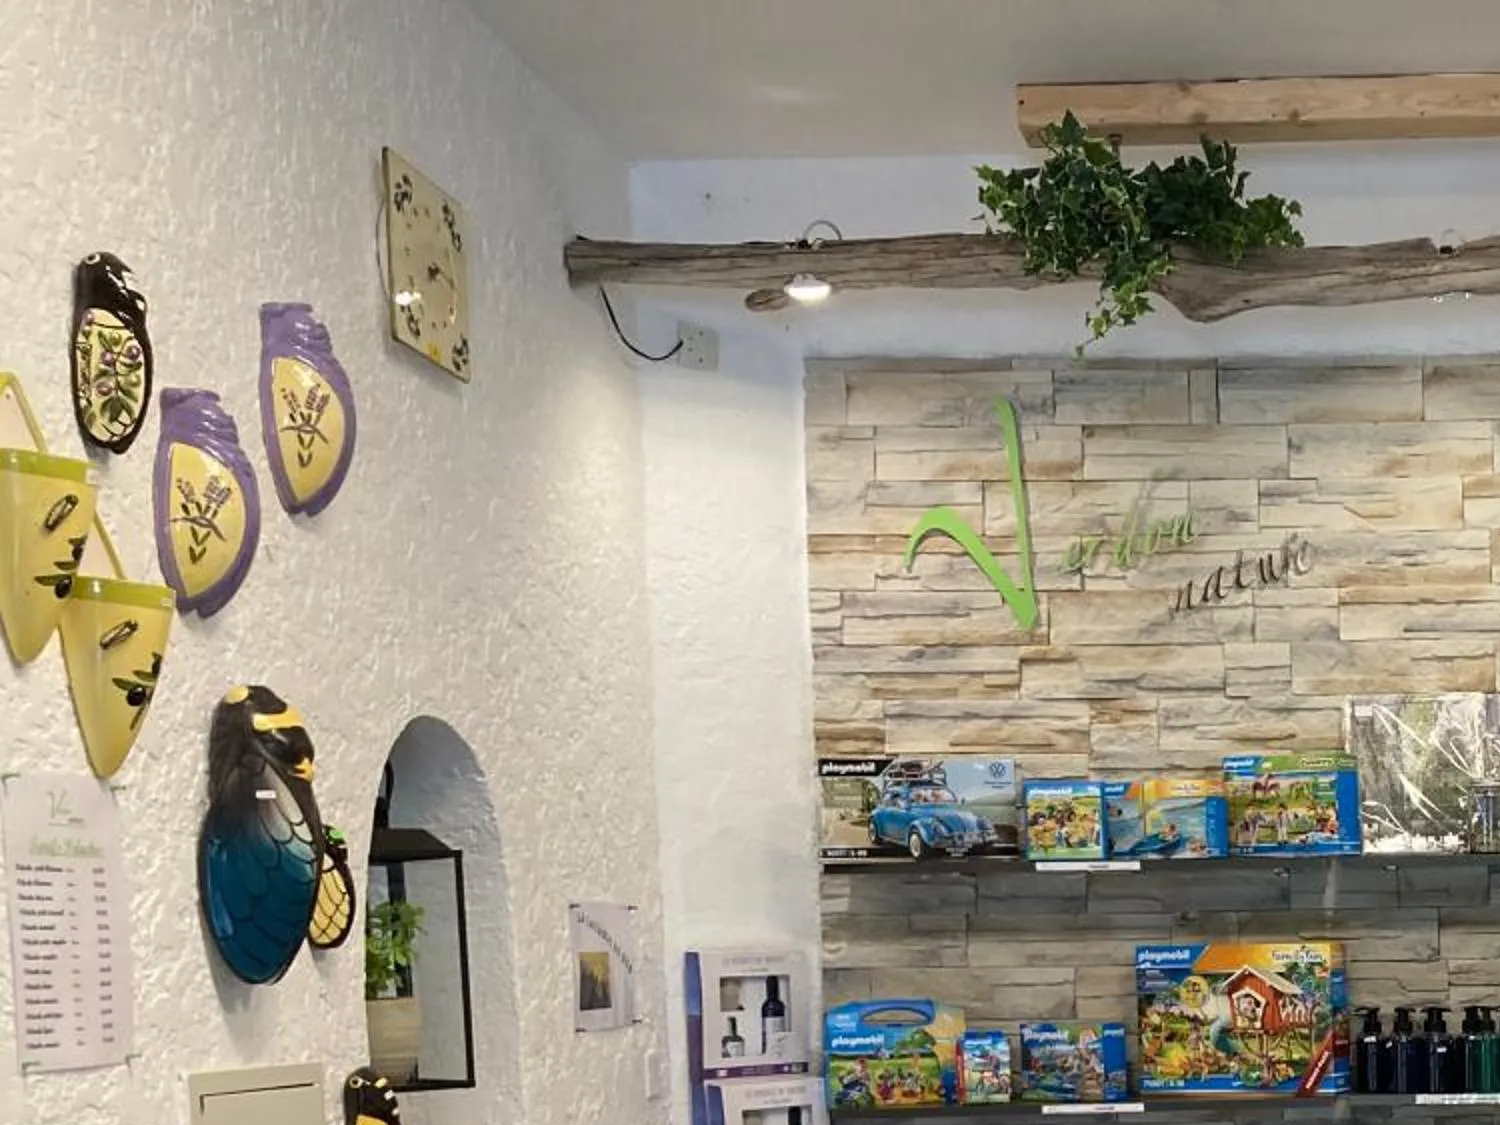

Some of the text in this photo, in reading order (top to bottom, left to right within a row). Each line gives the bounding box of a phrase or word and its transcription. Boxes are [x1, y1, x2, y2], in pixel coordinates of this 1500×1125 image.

[902, 394, 1197, 630] Verdon
[1169, 530, 1312, 621] nature
[821, 761, 876, 775] playmobil
[1138, 950, 1190, 962] playmobil
[831, 1034, 884, 1048] playmobil
